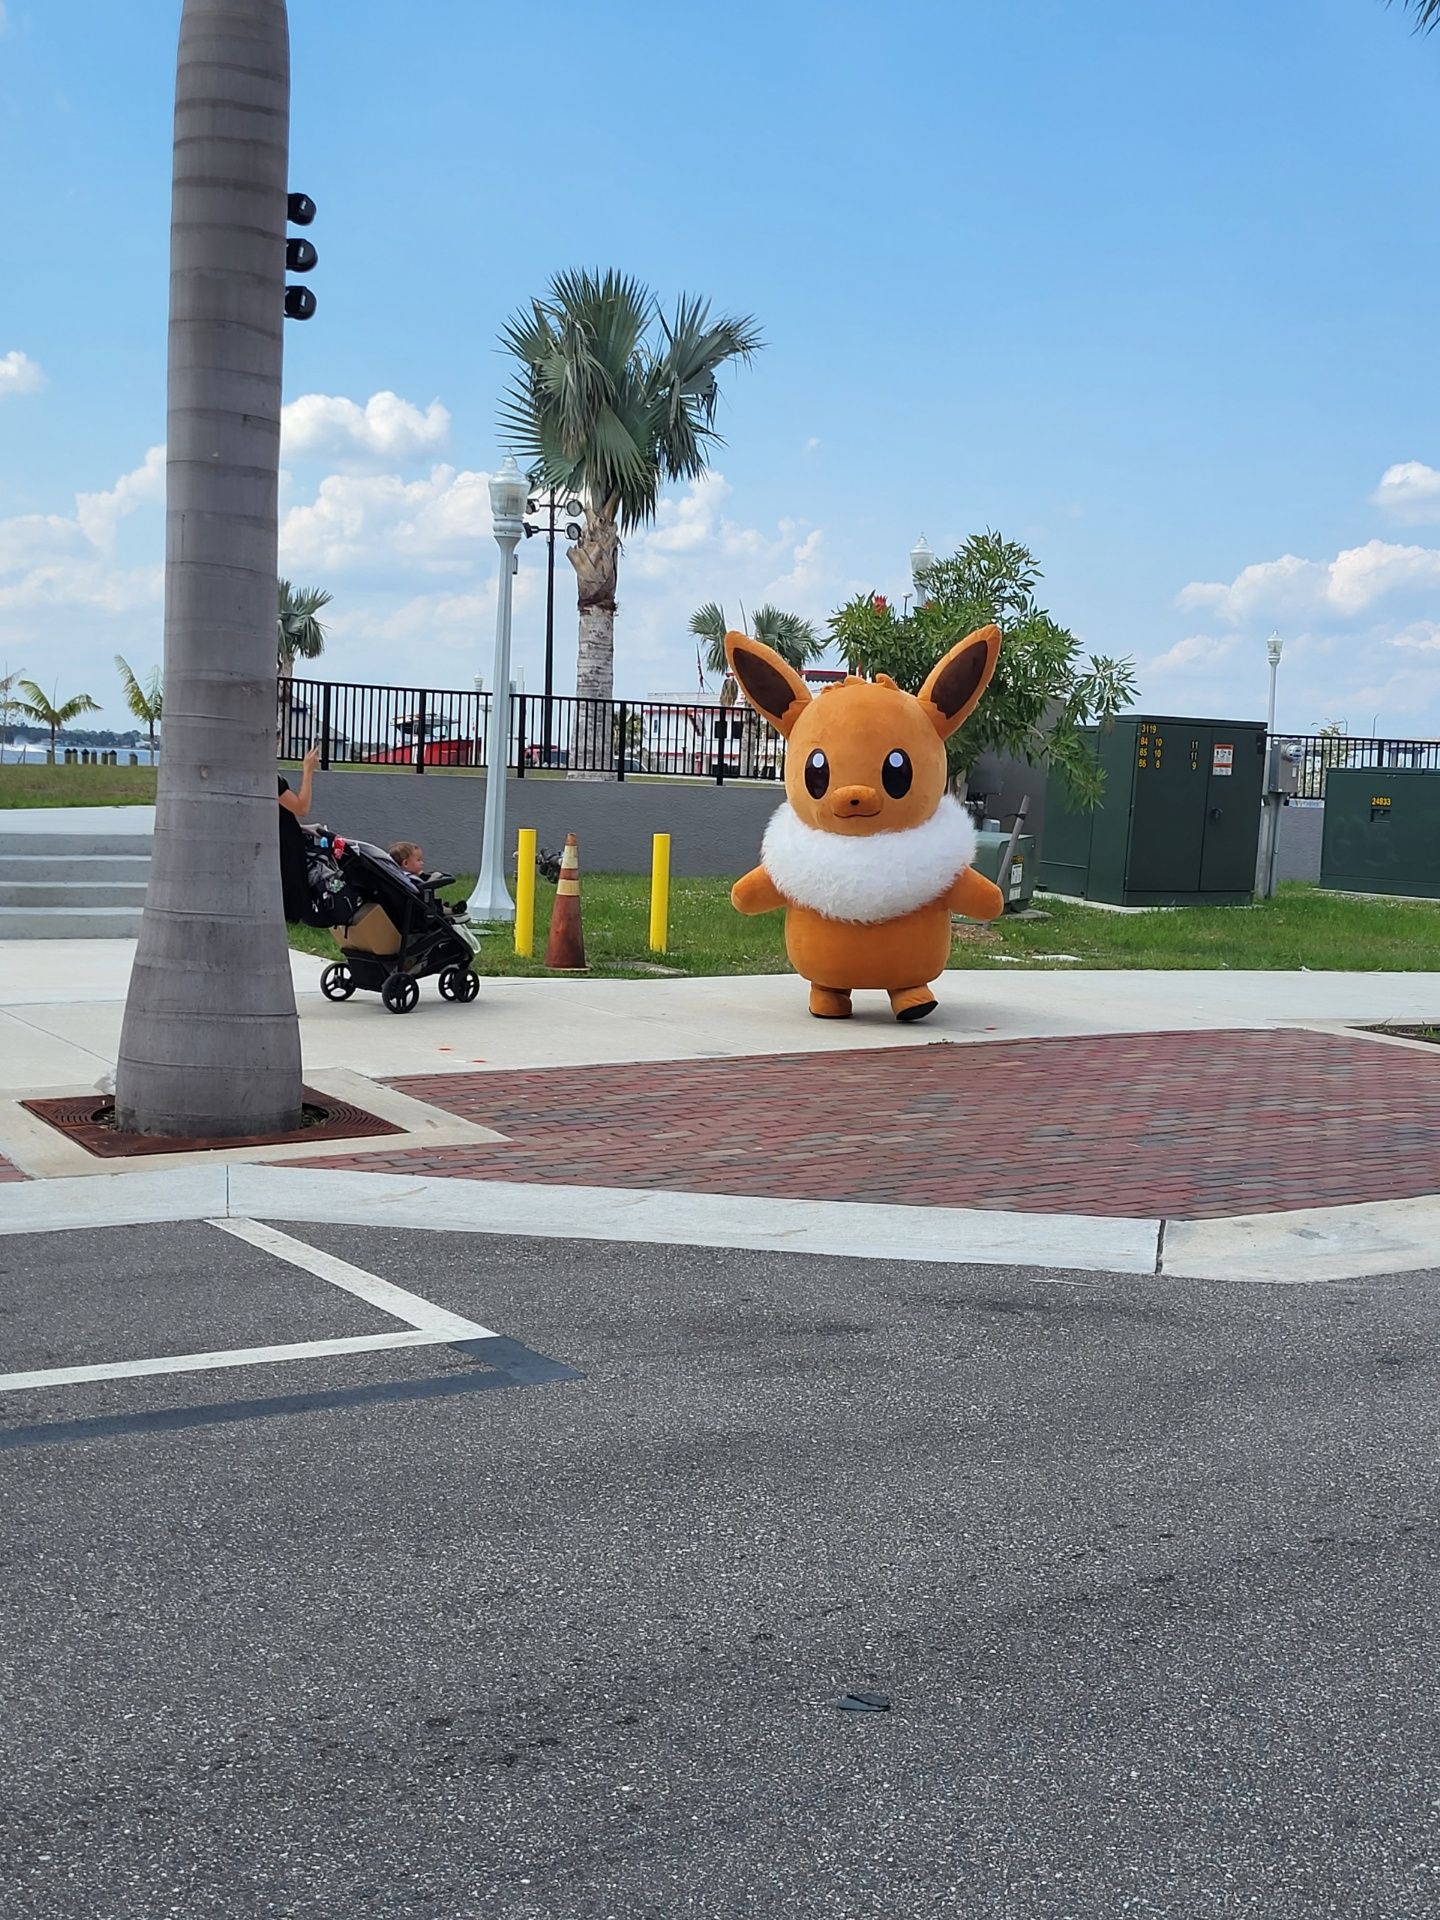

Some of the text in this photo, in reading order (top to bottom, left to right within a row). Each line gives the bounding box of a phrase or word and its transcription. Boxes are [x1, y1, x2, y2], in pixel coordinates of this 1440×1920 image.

[1155, 737, 1163, 747] 10
[1191, 741, 1199, 749] 11
[1190, 751, 1198, 760] 11
[1192, 761, 1197, 770] 9
